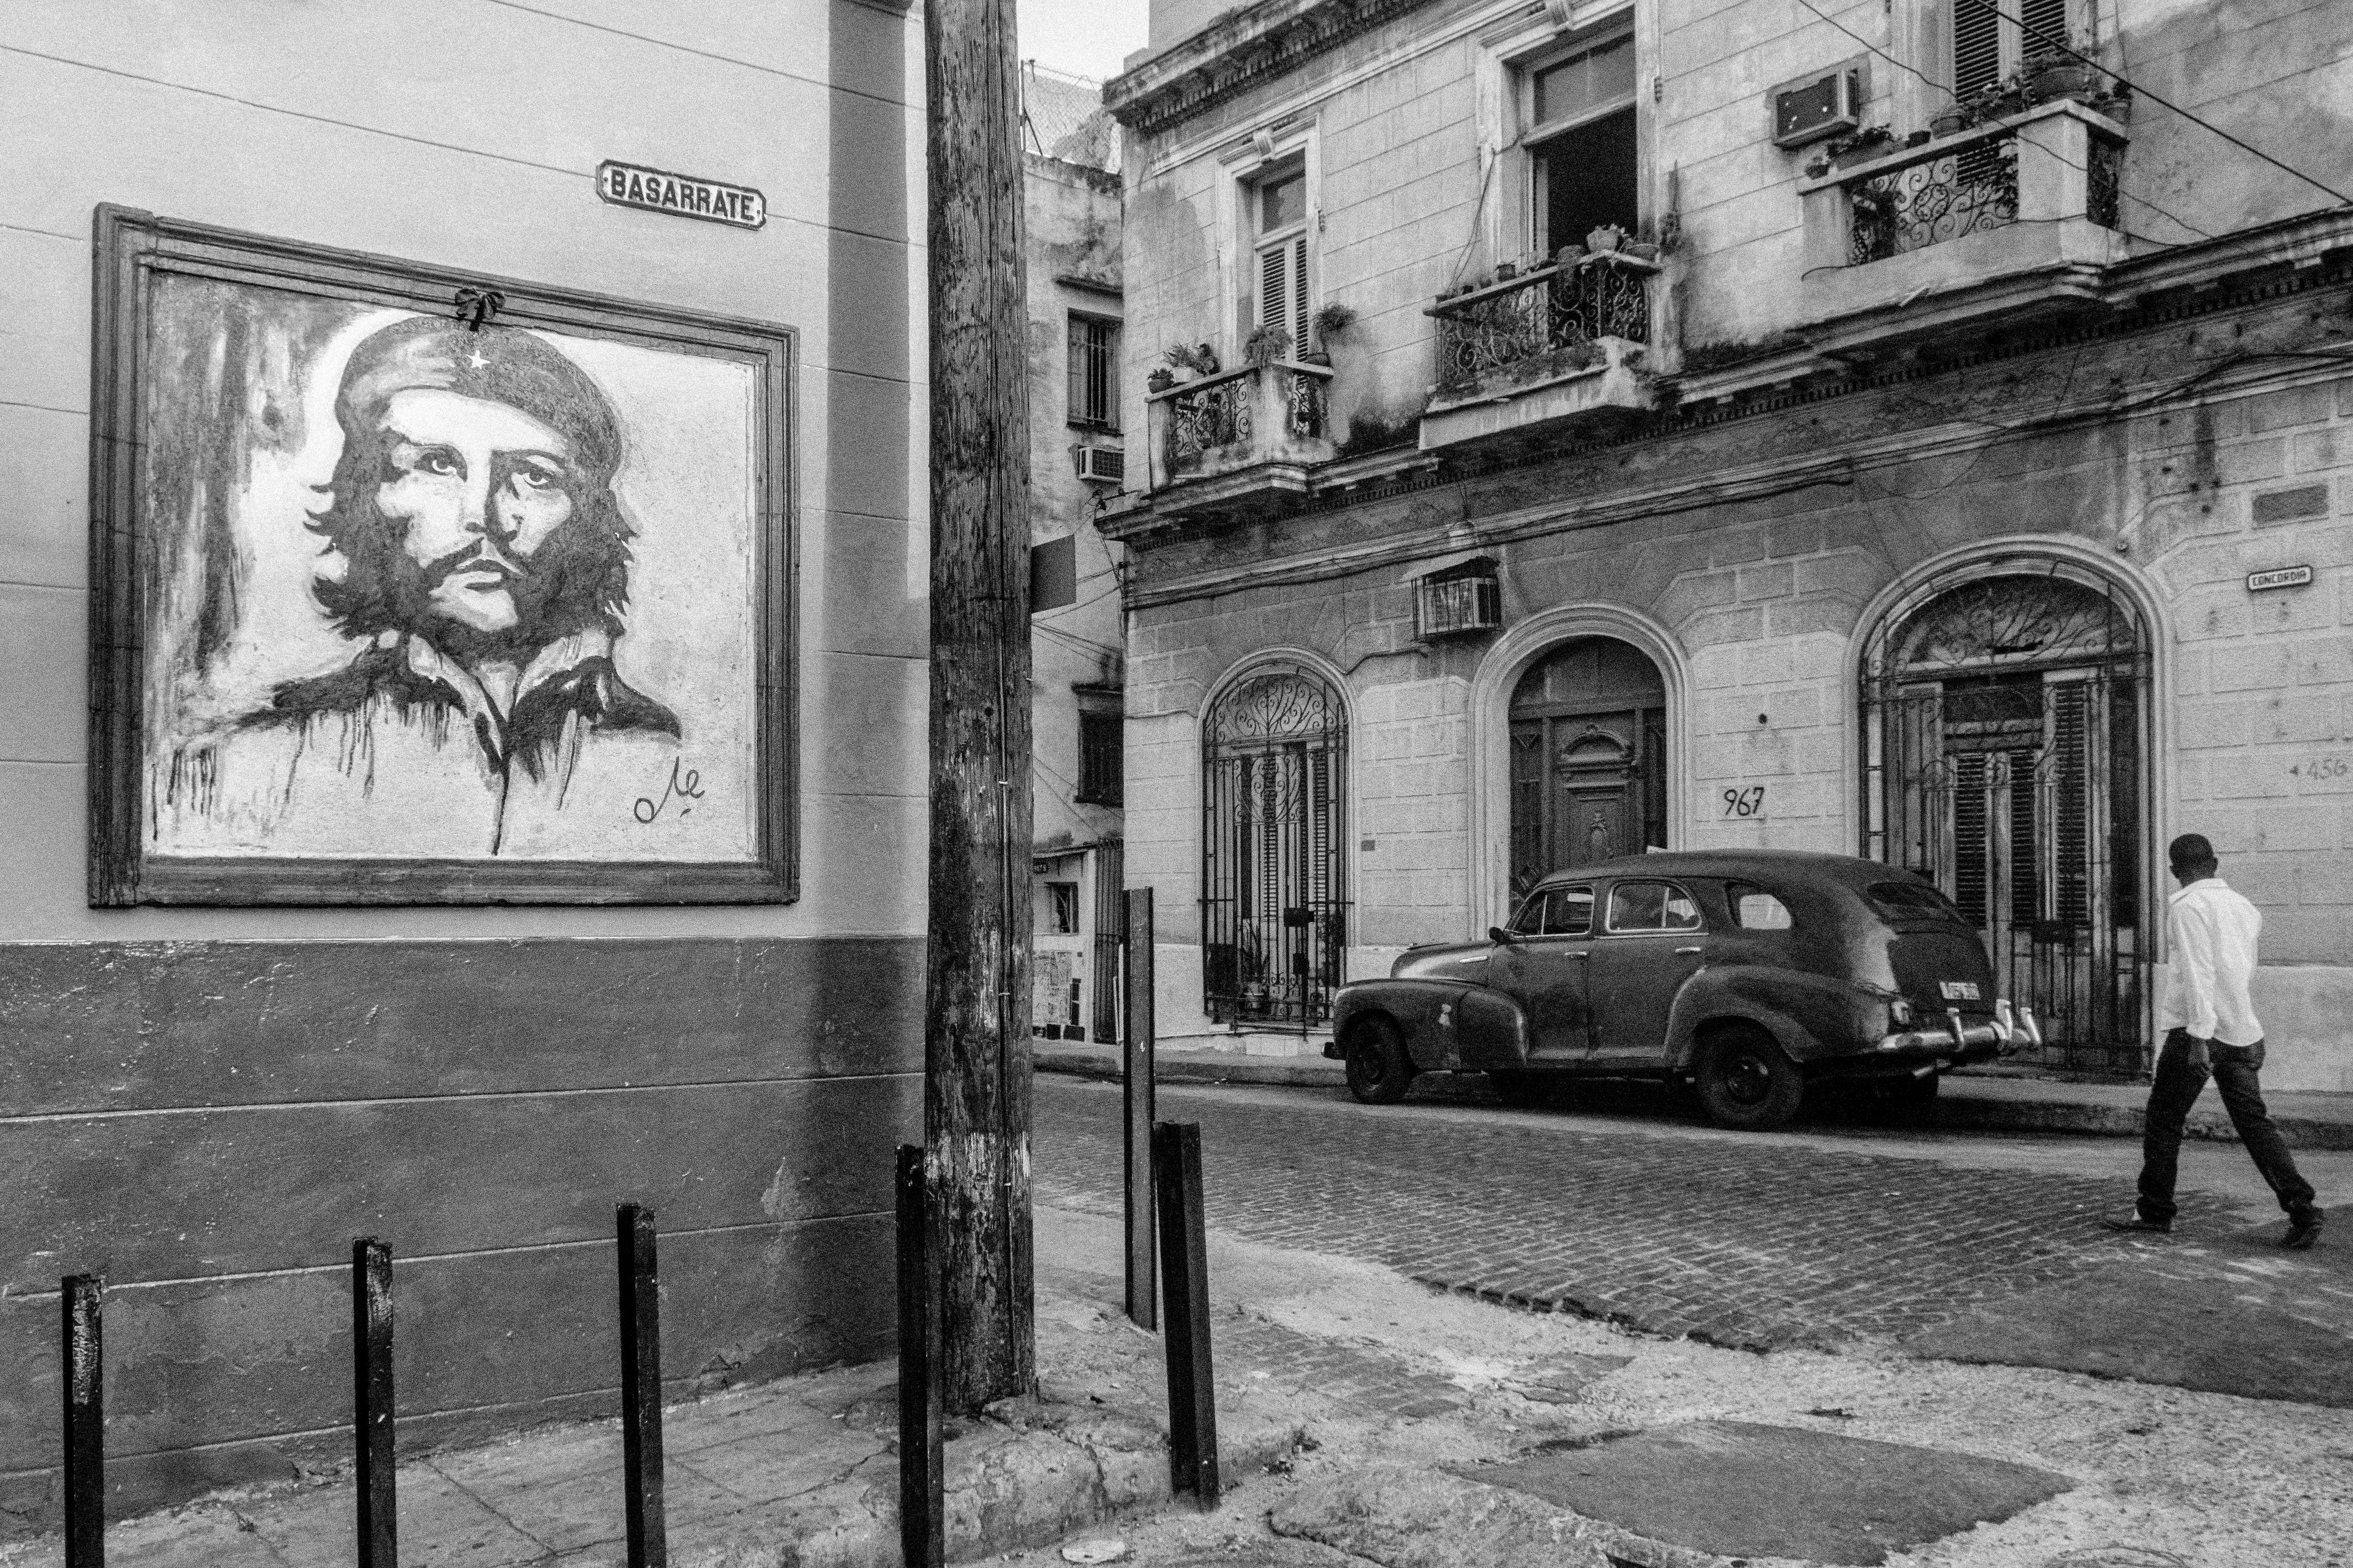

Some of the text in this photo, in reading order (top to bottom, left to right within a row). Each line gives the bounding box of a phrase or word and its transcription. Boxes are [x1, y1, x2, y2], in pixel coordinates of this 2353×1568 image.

[610, 168, 755, 221] BASARRATE
[2252, 570, 2307, 586] CONCORDIA
[1724, 787, 1764, 816] 967
